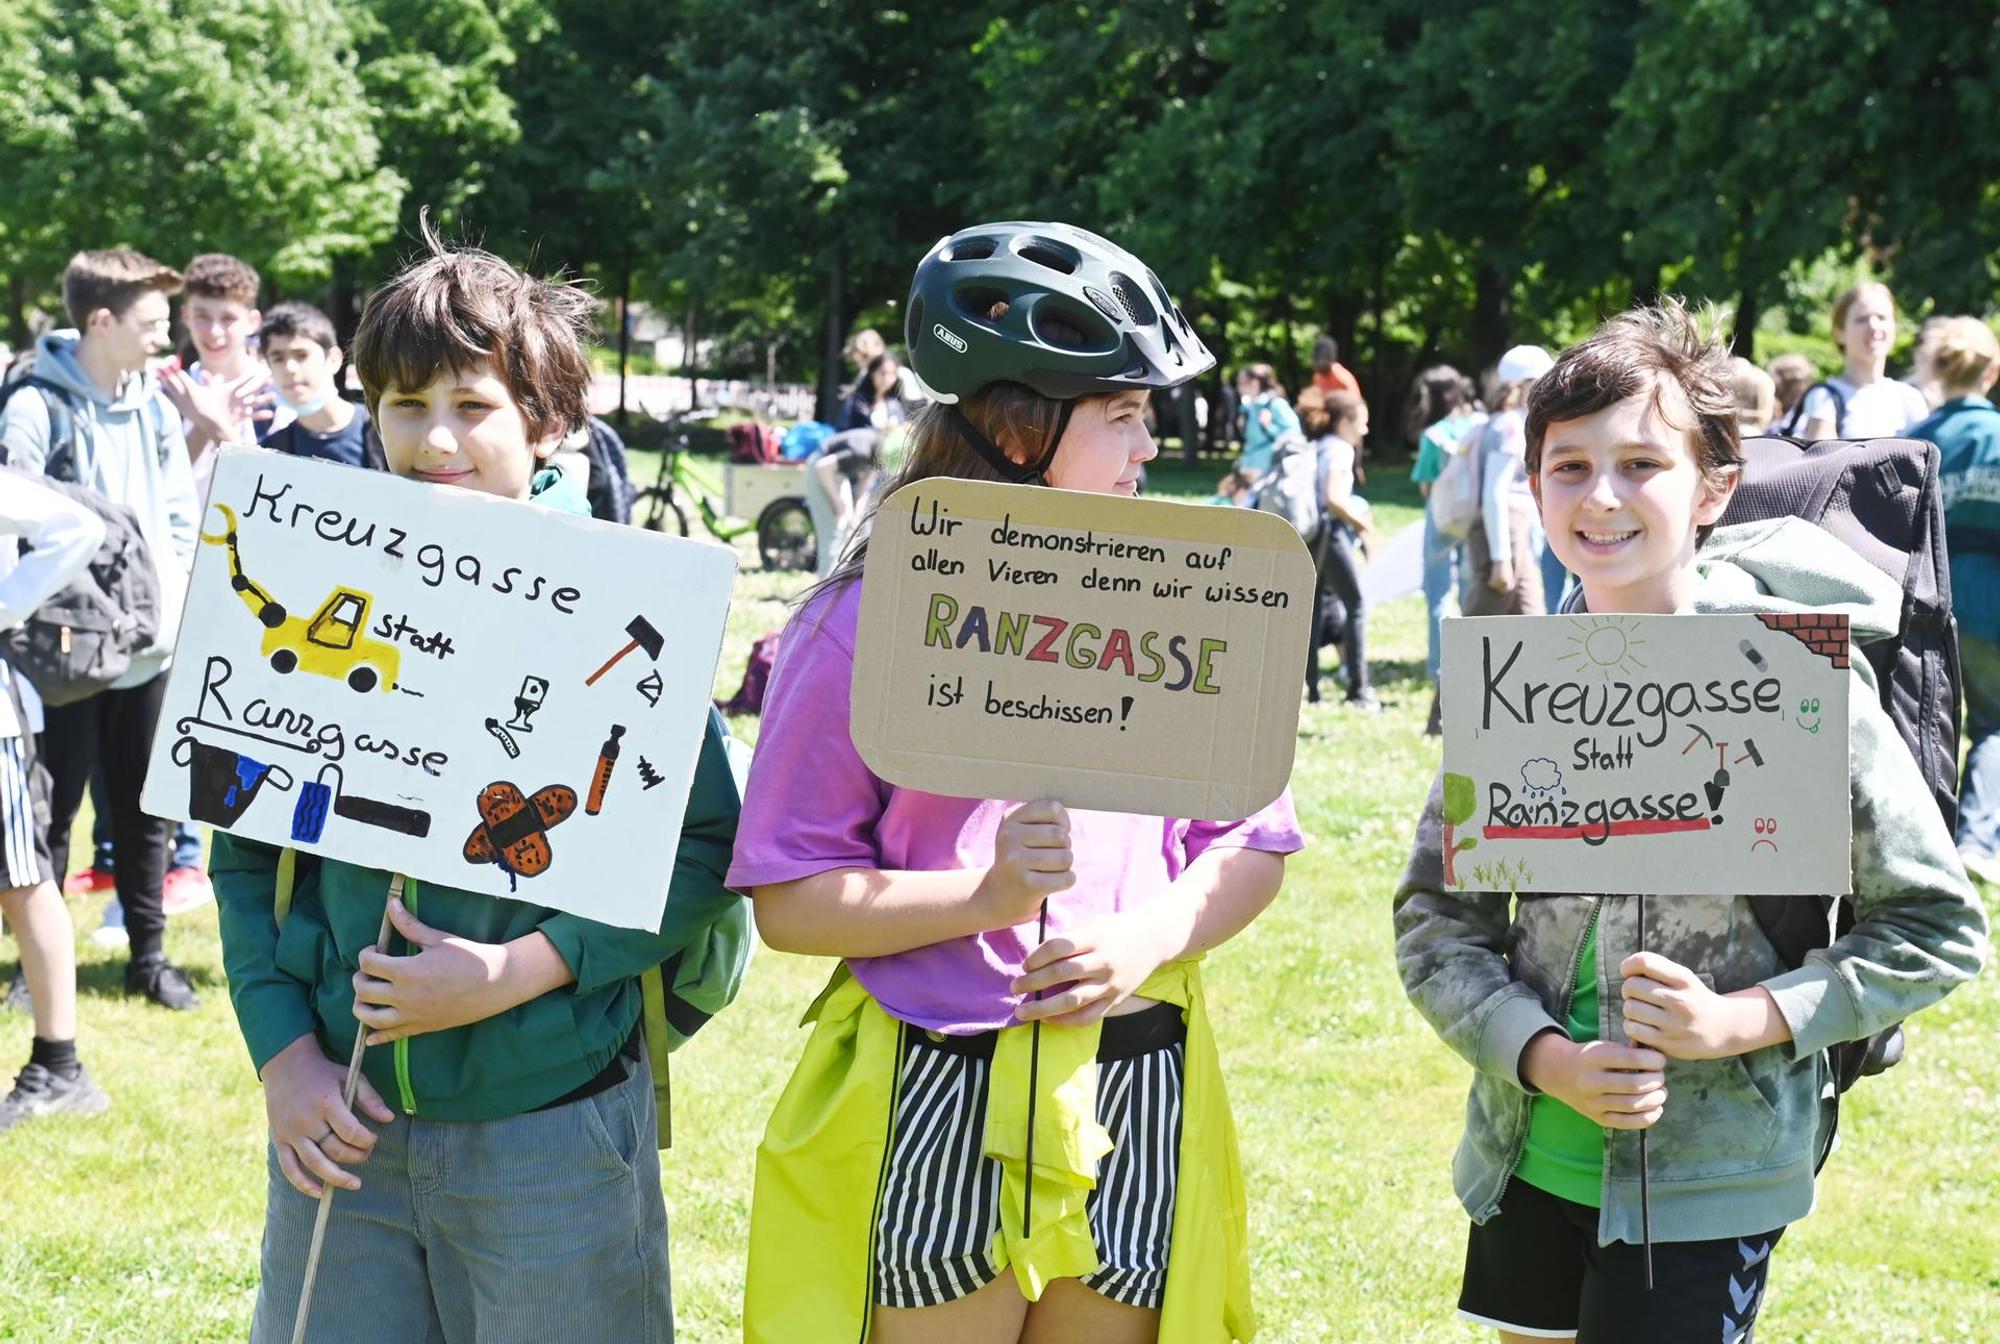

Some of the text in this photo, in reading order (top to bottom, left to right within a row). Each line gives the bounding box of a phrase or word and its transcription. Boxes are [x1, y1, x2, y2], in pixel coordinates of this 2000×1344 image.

[936, 327, 964, 350] ABUS
[242, 473, 582, 614] Kreuzgasse
[910, 496, 1232, 570] Wir demonstrieren auf
[911, 549, 1289, 608] allen Vieren denn wir wissen
[924, 593, 1227, 695] RANZGASSE
[198, 656, 448, 776] Ranzgasse
[927, 674, 1134, 732] ist beschissen!
[1482, 636, 1781, 747] Kreuzgasse
[1487, 781, 1724, 846] Ranzgasse!
